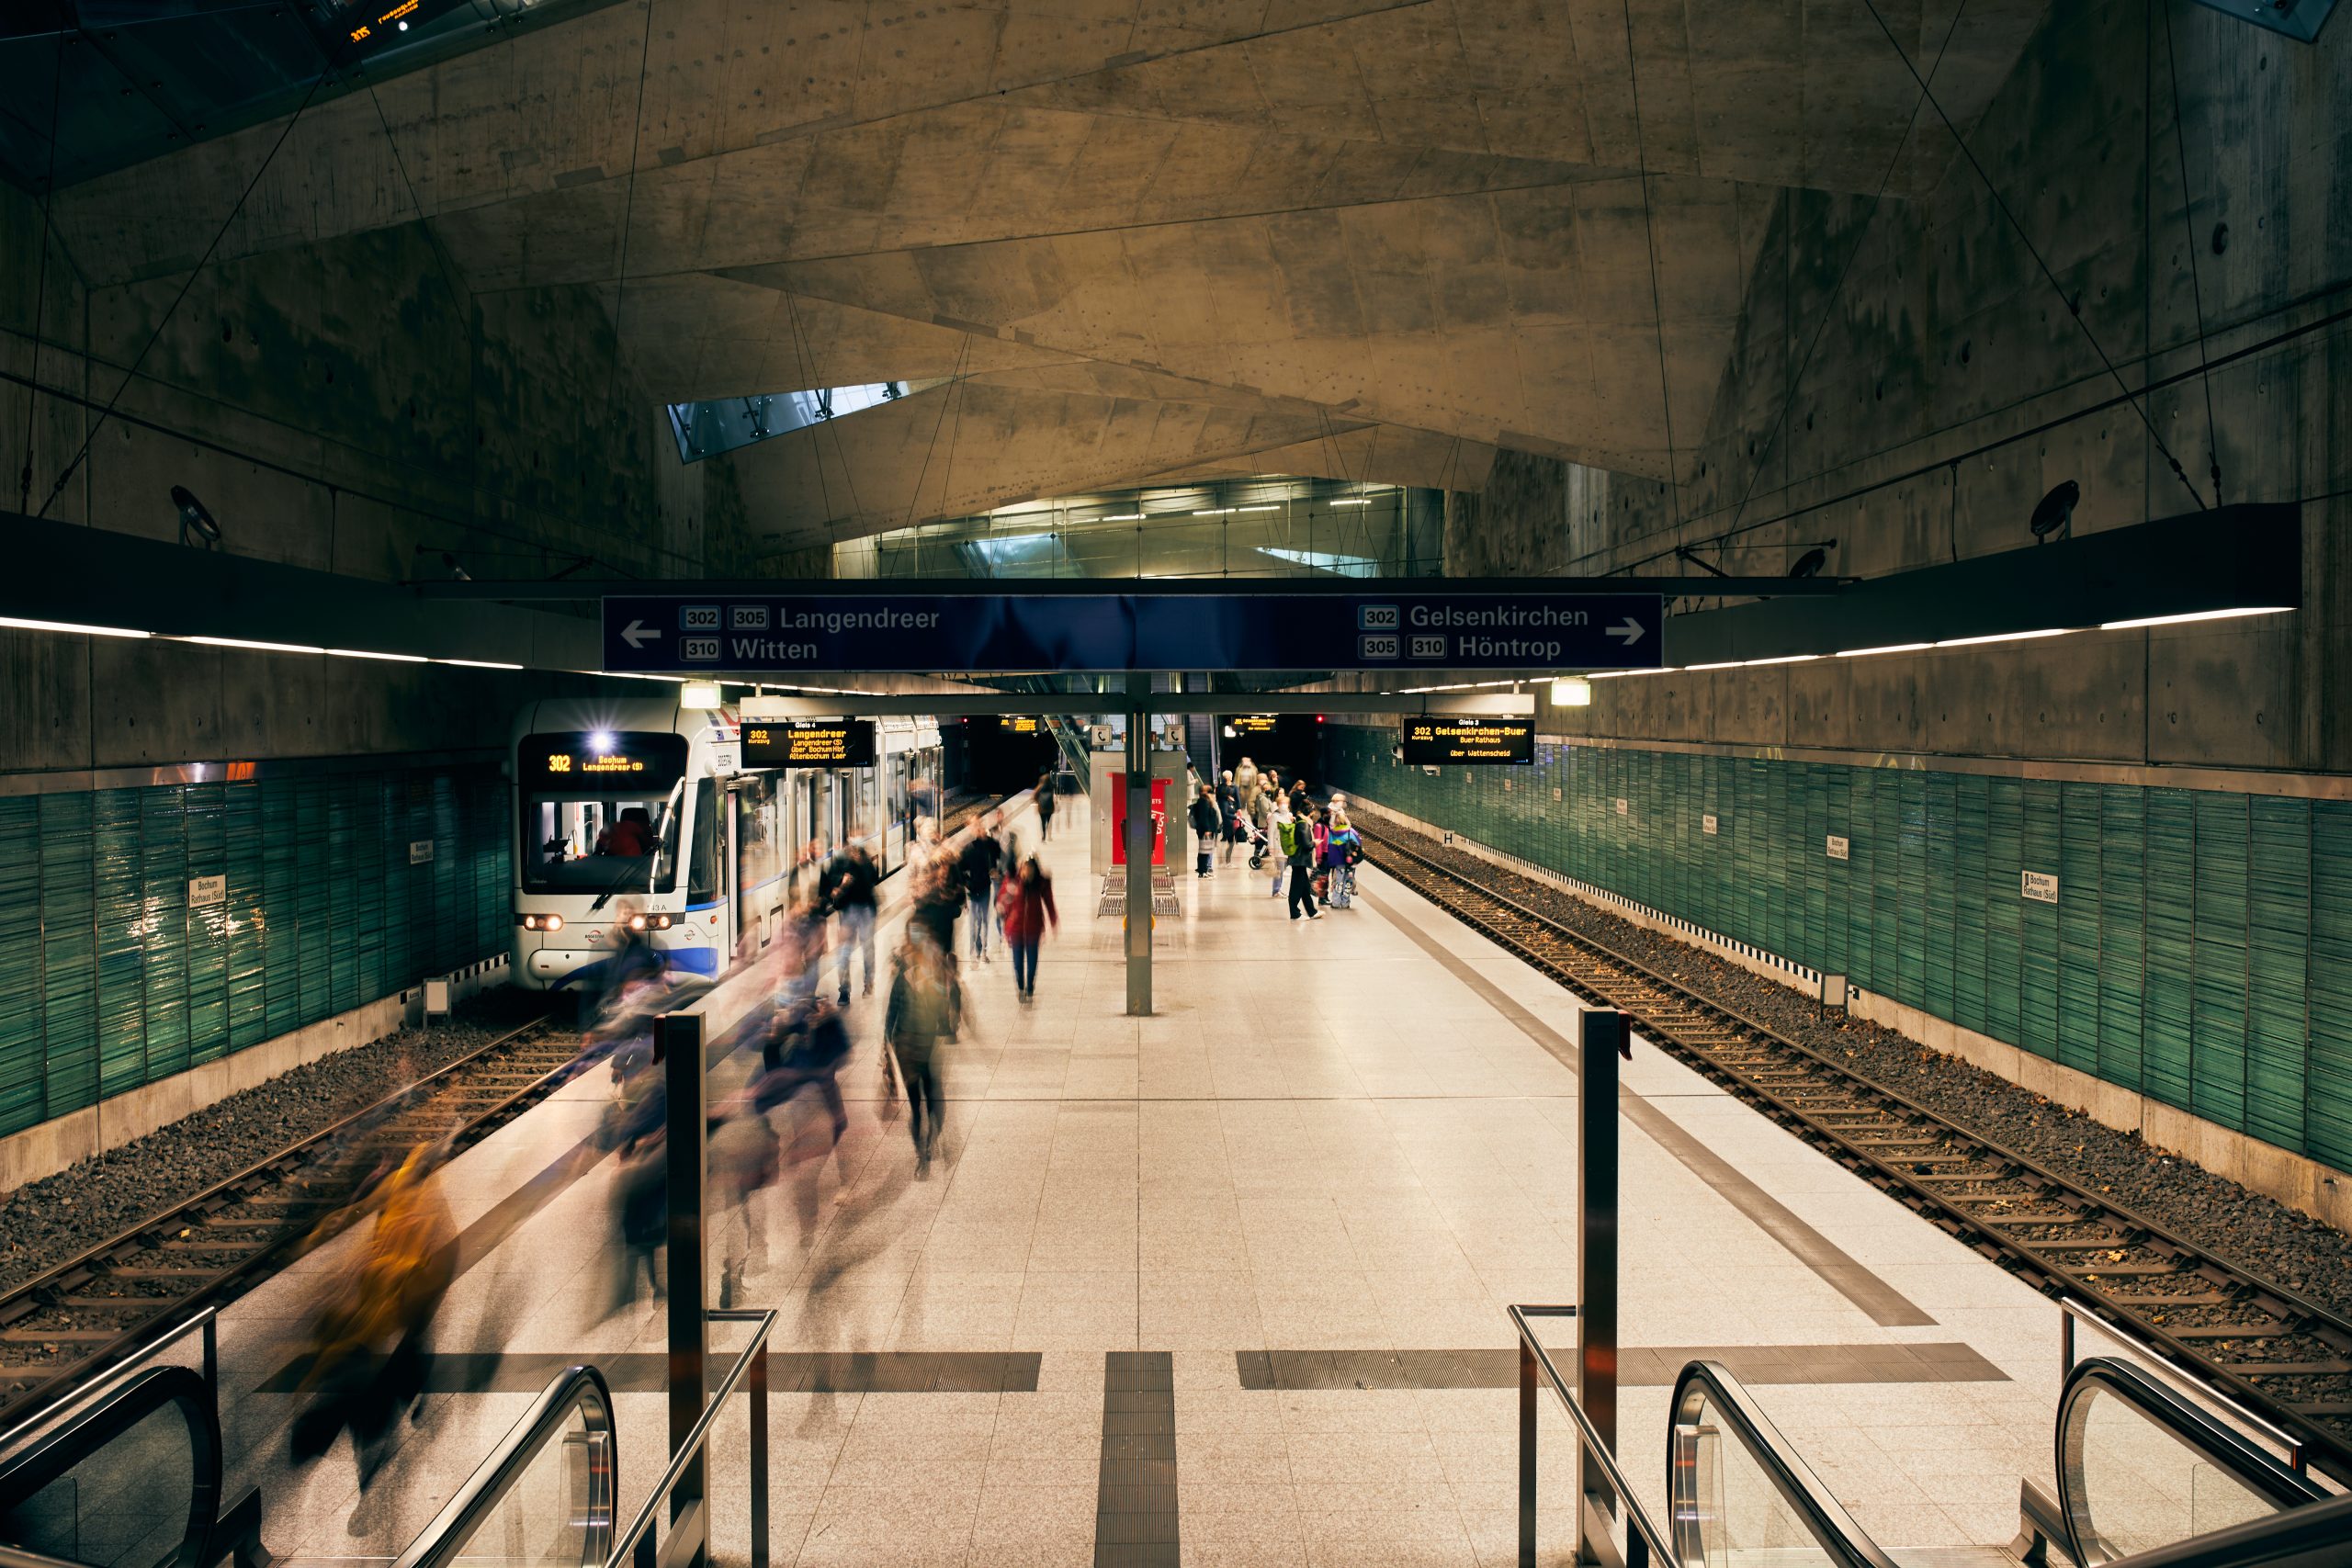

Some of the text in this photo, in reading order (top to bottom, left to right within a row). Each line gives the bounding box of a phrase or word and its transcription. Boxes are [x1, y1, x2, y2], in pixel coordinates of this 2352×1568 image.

[687, 607, 940, 634] 302 305 Langendreer
[1366, 605, 1588, 626] 302 Gelsenkirchen
[688, 638, 818, 660] 310 Witten
[1366, 637, 1561, 661] 305 310 Höntrop
[750, 730, 847, 739] 302 Langendreer
[1414, 727, 1527, 736] 302 Gelsenkirchen-Buer
[548, 755, 571, 772] 302
[598, 755, 628, 764] Bochum
[582, 762, 643, 772] Langendreer (S)
[1444, 833, 1453, 844] H
[198, 879, 218, 891] Bochum
[2030, 874, 2050, 887] Bochum
[191, 889, 224, 904] Rathaus (Süd)
[2024, 886, 2056, 901] Rathaus (Süd)
